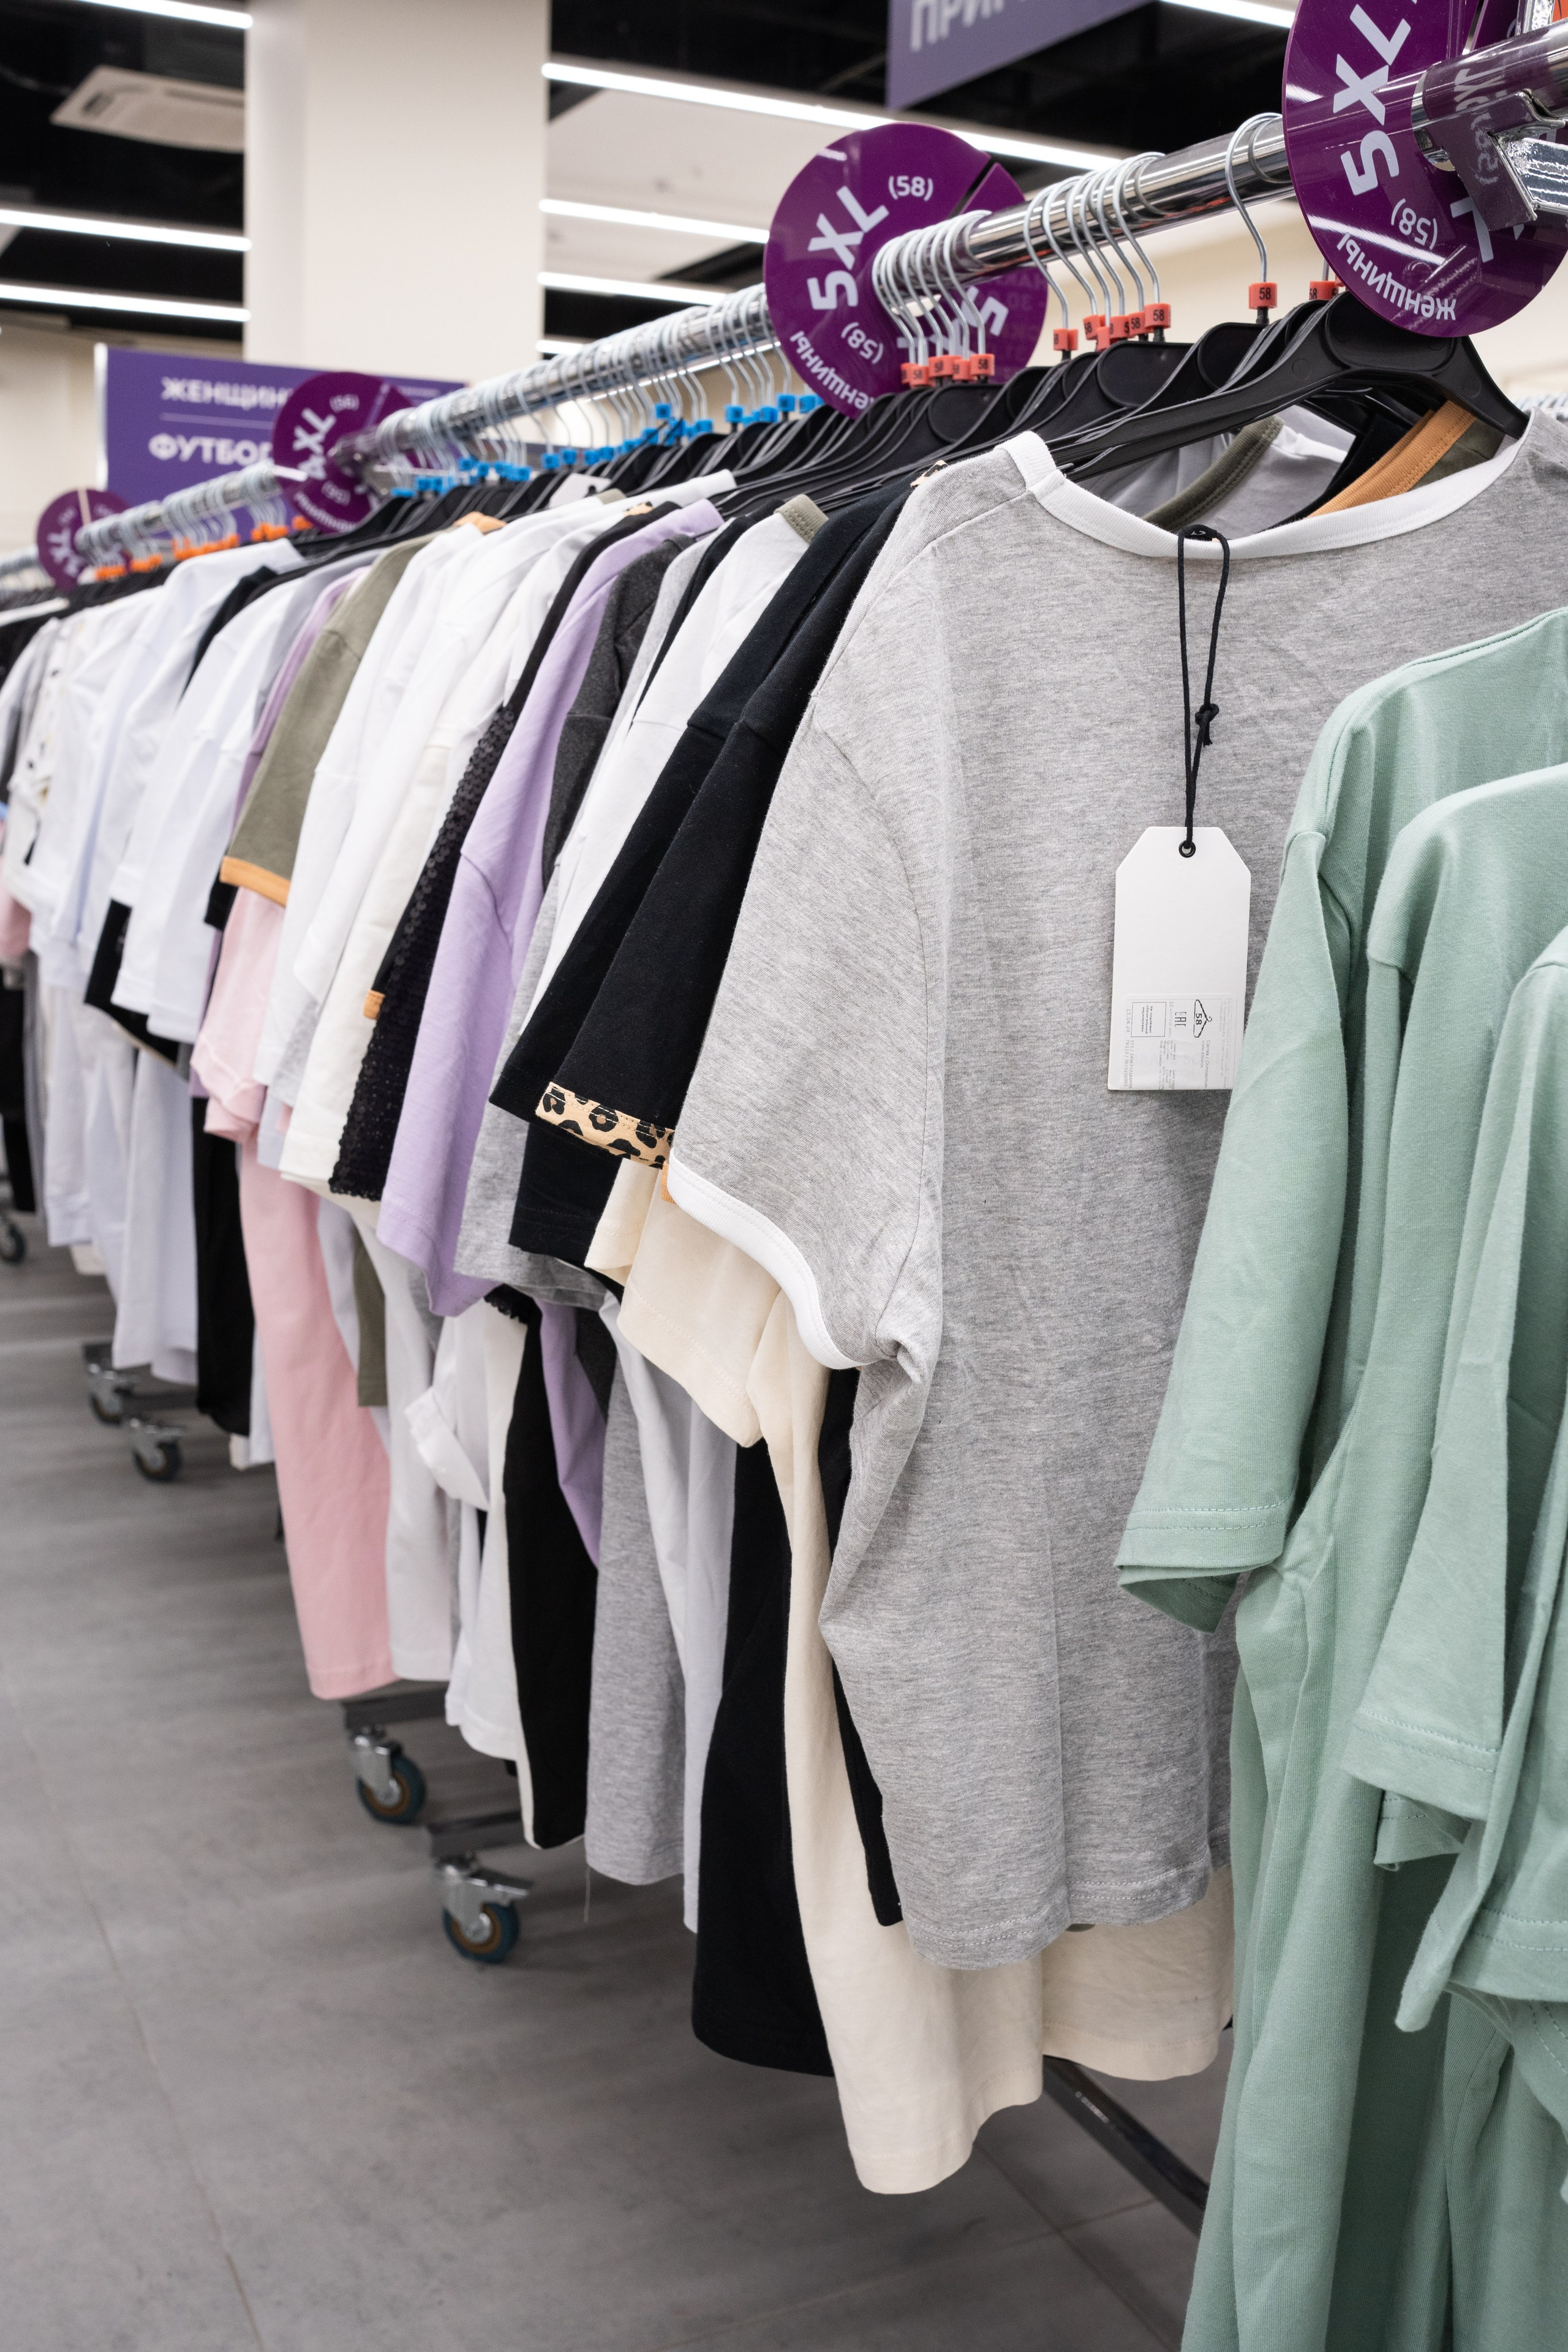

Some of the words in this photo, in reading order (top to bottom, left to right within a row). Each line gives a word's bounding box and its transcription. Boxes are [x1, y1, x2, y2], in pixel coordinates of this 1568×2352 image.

[1333, 4, 1411, 196] 5XL
[888, 175, 934, 202] (58)
[1392, 198, 1438, 249] (58)
[807, 186, 889, 311] 5XL
[1259, 287, 1271, 300] 58
[1337, 233, 1456, 321] женщины
[1131, 317, 1140, 330] 58
[1153, 309, 1165, 322] 58
[841, 322, 884, 364] (58)
[790, 331, 875, 410] енщины
[160, 375, 295, 411] ЖЕНЩИН
[1196, 1013, 1202, 1025] 58
